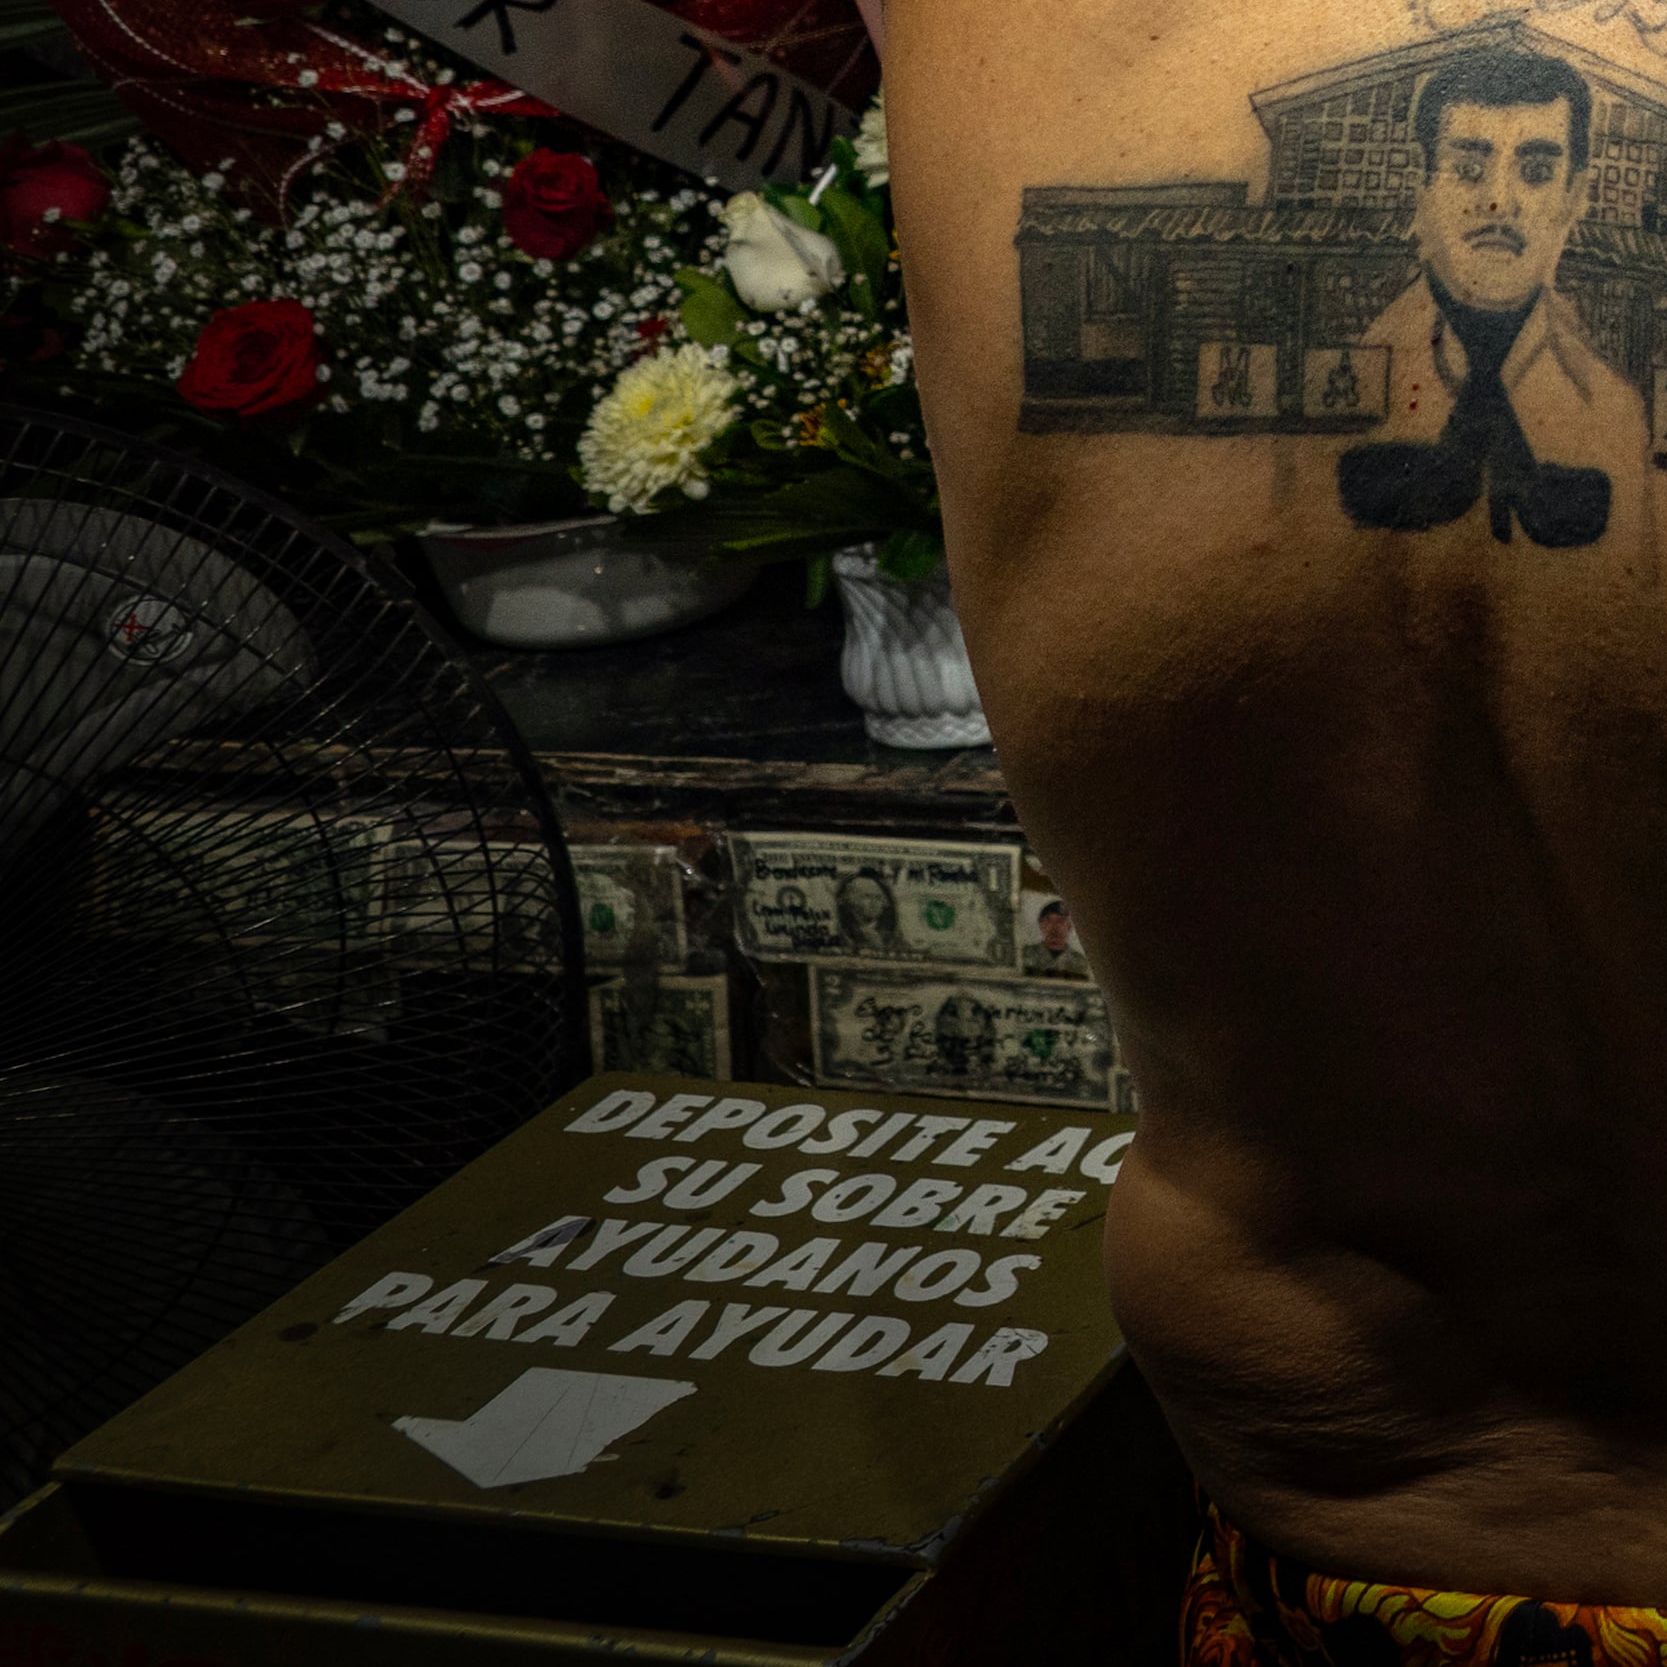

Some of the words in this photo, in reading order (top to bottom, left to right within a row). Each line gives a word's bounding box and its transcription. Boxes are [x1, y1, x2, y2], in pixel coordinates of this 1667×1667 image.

[563, 1087, 1018, 1170] DEPOSITE
[1002, 1125, 1138, 1187] AQ
[603, 1155, 764, 1211] SU
[749, 1167, 1088, 1241] SOBRE
[488, 1214, 1044, 1309] AYUDANOS
[332, 1270, 617, 1349] PARA
[606, 1298, 1050, 1389] AYUDAR
